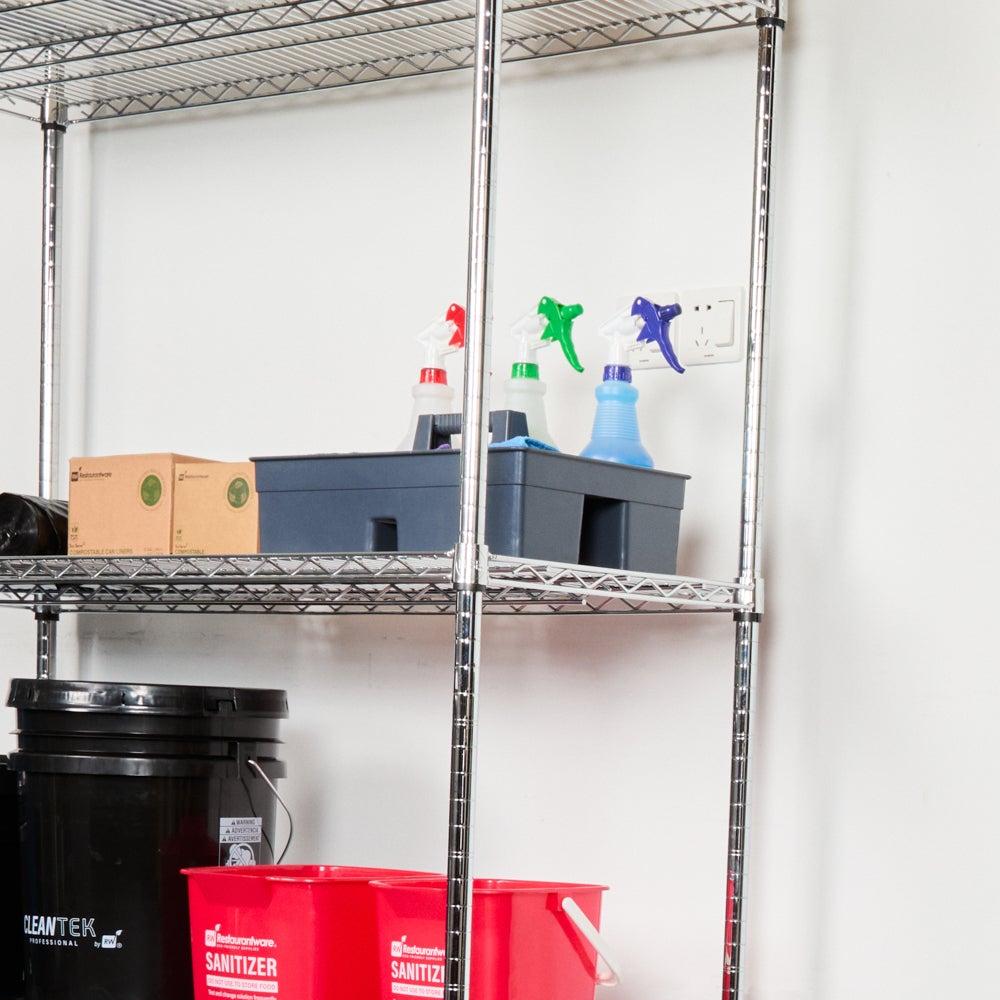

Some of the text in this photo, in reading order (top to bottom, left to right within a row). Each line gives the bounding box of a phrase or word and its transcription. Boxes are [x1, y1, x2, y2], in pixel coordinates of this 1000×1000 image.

[24, 914, 96, 937] CLEANTEK
[29, 937, 78, 947] PROFESSIONAL
[94, 940, 100, 948] by
[402, 943, 445, 956] Restaurantw
[206, 951, 277, 977] SANITIZER
[391, 960, 445, 983] SANITIZ
